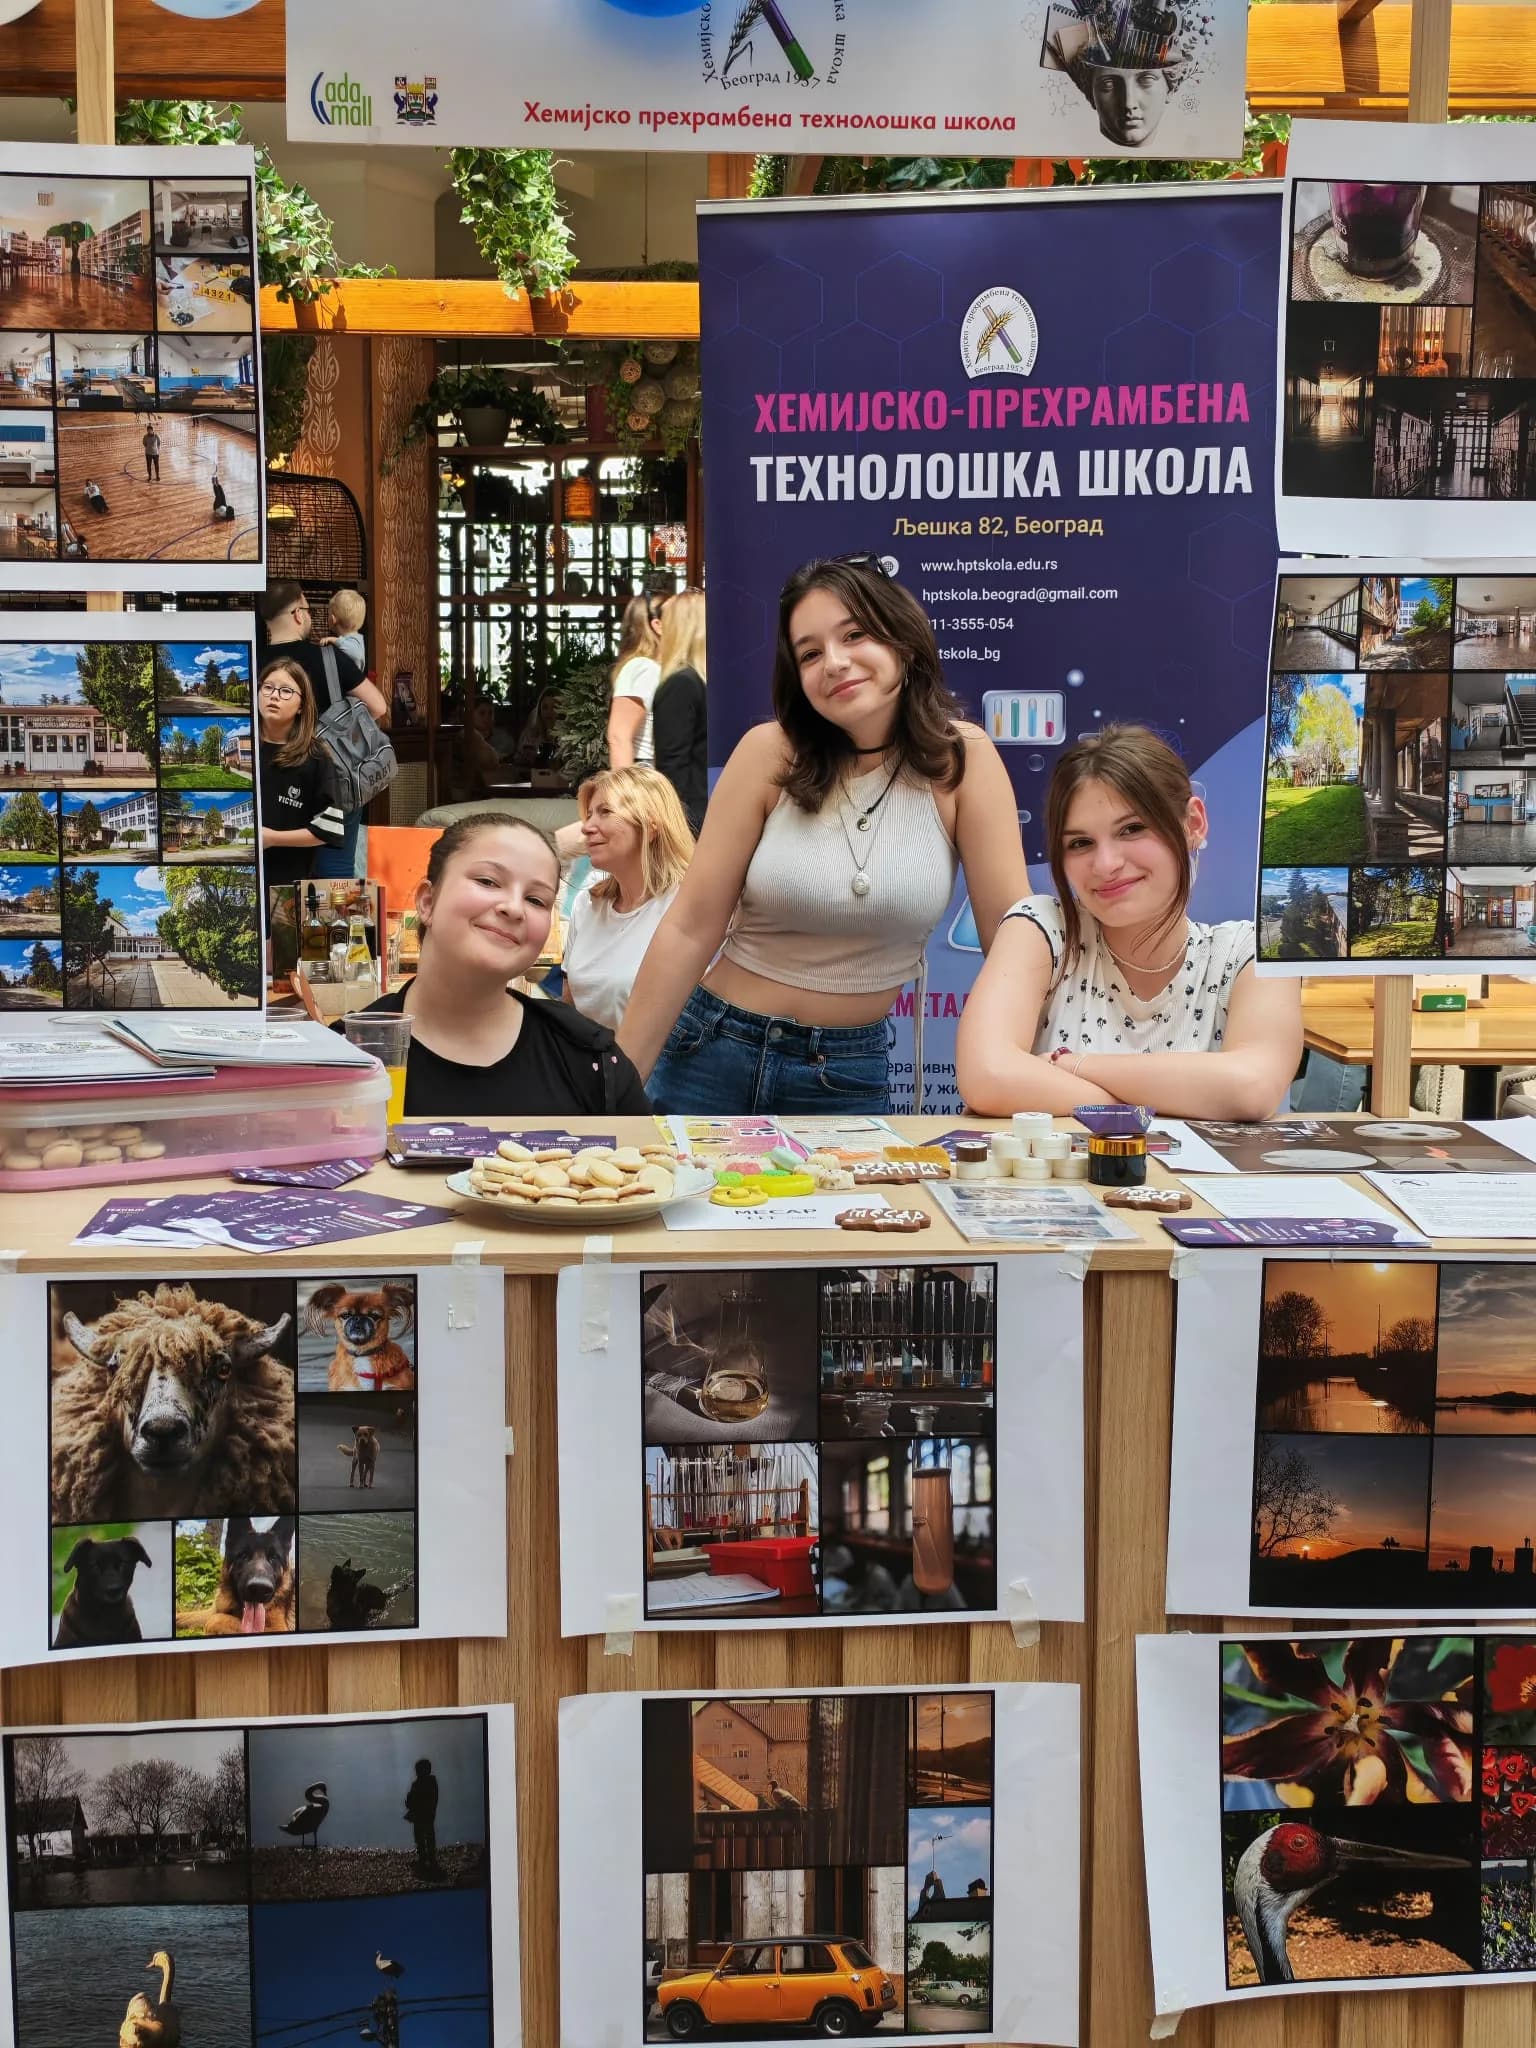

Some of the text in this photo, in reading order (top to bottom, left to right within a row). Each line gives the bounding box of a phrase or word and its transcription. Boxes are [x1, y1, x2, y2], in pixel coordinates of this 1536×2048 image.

[325, 72, 360, 102] ada
[720, 71, 780, 90] Београд
[331, 96, 372, 126] mall
[524, 102, 1016, 133] Хемијско прехрамбена технолошка школа
[754, 382, 1250, 433] ХЕМИЈСКО-ПРЕХРАМБЕНА
[750, 446, 1254, 503] ТЕХНОЛОШКА ШКОЛА
[892, 516, 1104, 538] Љешка 82, Београд
[921, 557, 1058, 574] www.hptskola.edu.rs
[922, 586, 1118, 603] hptskola.beograd@gmail.com
[928, 618, 1014, 631] 11-3555-054
[938, 647, 1001, 662] tskola_bg
[368, 759, 391, 787] BABY
[888, 1062, 957, 1077] ераивну
